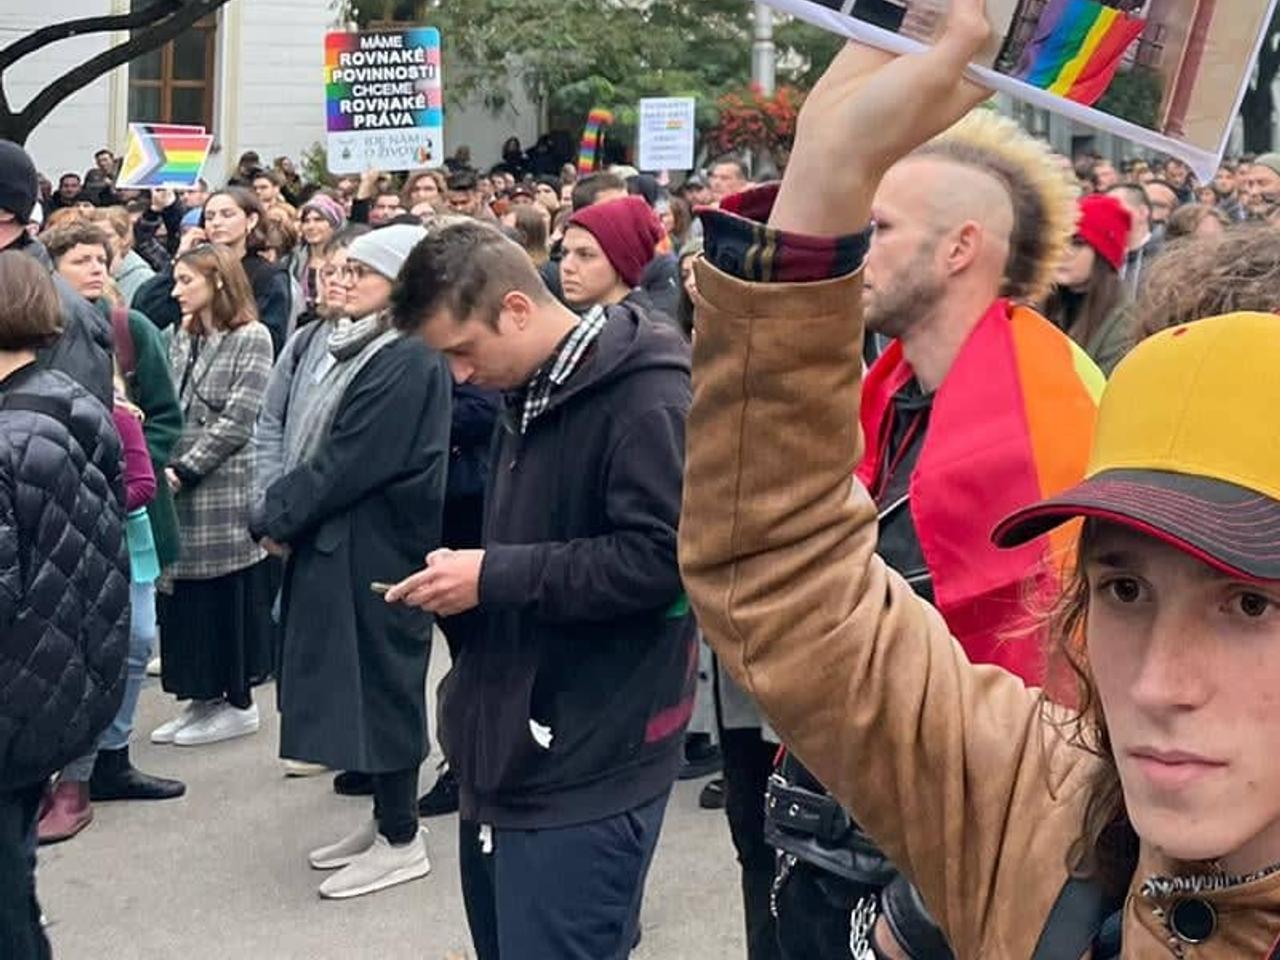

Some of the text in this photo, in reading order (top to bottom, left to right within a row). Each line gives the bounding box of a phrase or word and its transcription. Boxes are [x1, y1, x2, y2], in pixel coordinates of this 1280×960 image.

[339, 48, 425, 66] ROVNAKÉ
[332, 65, 433, 83] POVINNOSTI
[353, 82, 413, 97] CHCEME
[340, 95, 426, 113] ROVNAKÉ
[353, 110, 414, 128] PRÁVA
